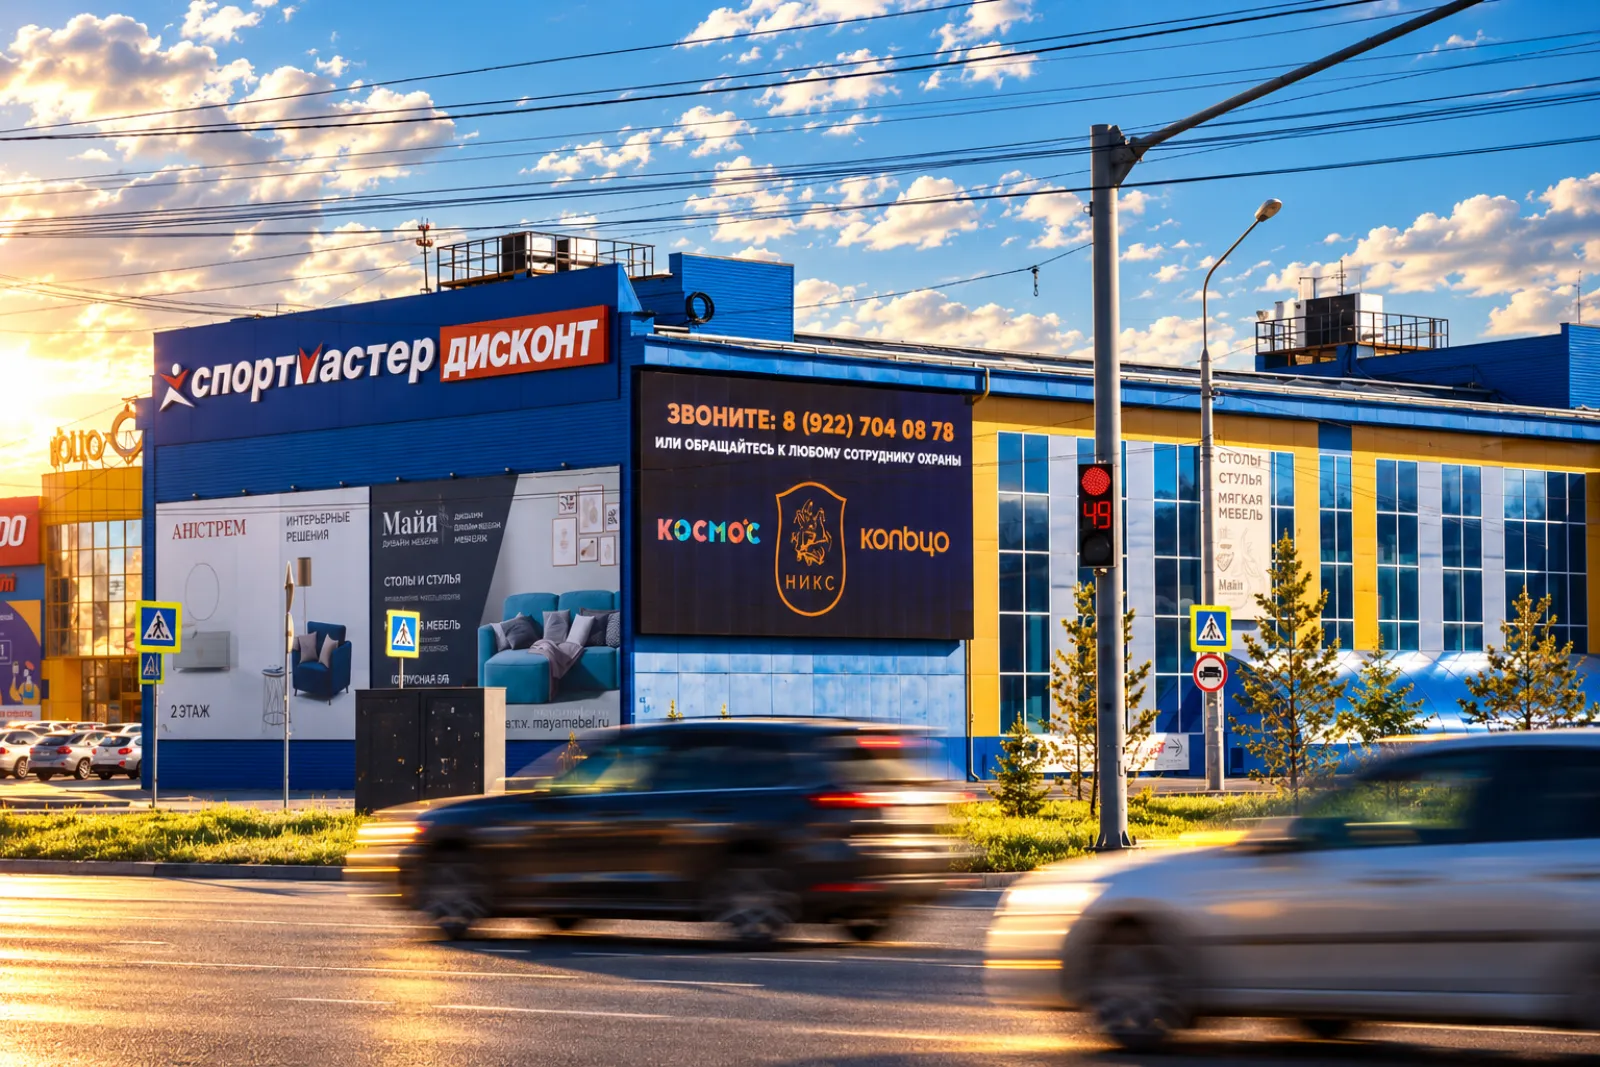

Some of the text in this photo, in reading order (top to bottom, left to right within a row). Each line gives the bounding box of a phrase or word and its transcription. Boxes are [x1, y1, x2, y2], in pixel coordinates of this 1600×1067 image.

[443, 318, 599, 379] ДИСКОНТ
[667, 402, 955, 442] ЗВОНИТЕ: 8 (922) 704 08 78
[655, 436, 962, 467] ИЛИ ОБРАЩАЙТЕСЬ К ЛЮБОМУ СОТРУДНИКУ ОХРАНЫ
[1218, 452, 1262, 467] СТОЛЫ
[1218, 472, 1263, 486] СТУЛЬЯ
[1218, 492, 1263, 505] МЯГКАЯ
[286, 511, 351, 527] ИНТЕРЬЕРНЫЕ
[1083, 501, 1112, 529] 49
[1218, 507, 1264, 521] МЕБЕЛЬ
[382, 509, 438, 536] Майя
[286, 528, 329, 543] РЕШЕНИЯ
[657, 518, 761, 545] КОСМОС
[383, 573, 462, 587] СТОЛЫ И СТУЛЬЯ
[785, 574, 835, 591] НИКС
[170, 704, 210, 718] 2 ЭТАЖ
[533, 715, 610, 731] mayamebel.ru
